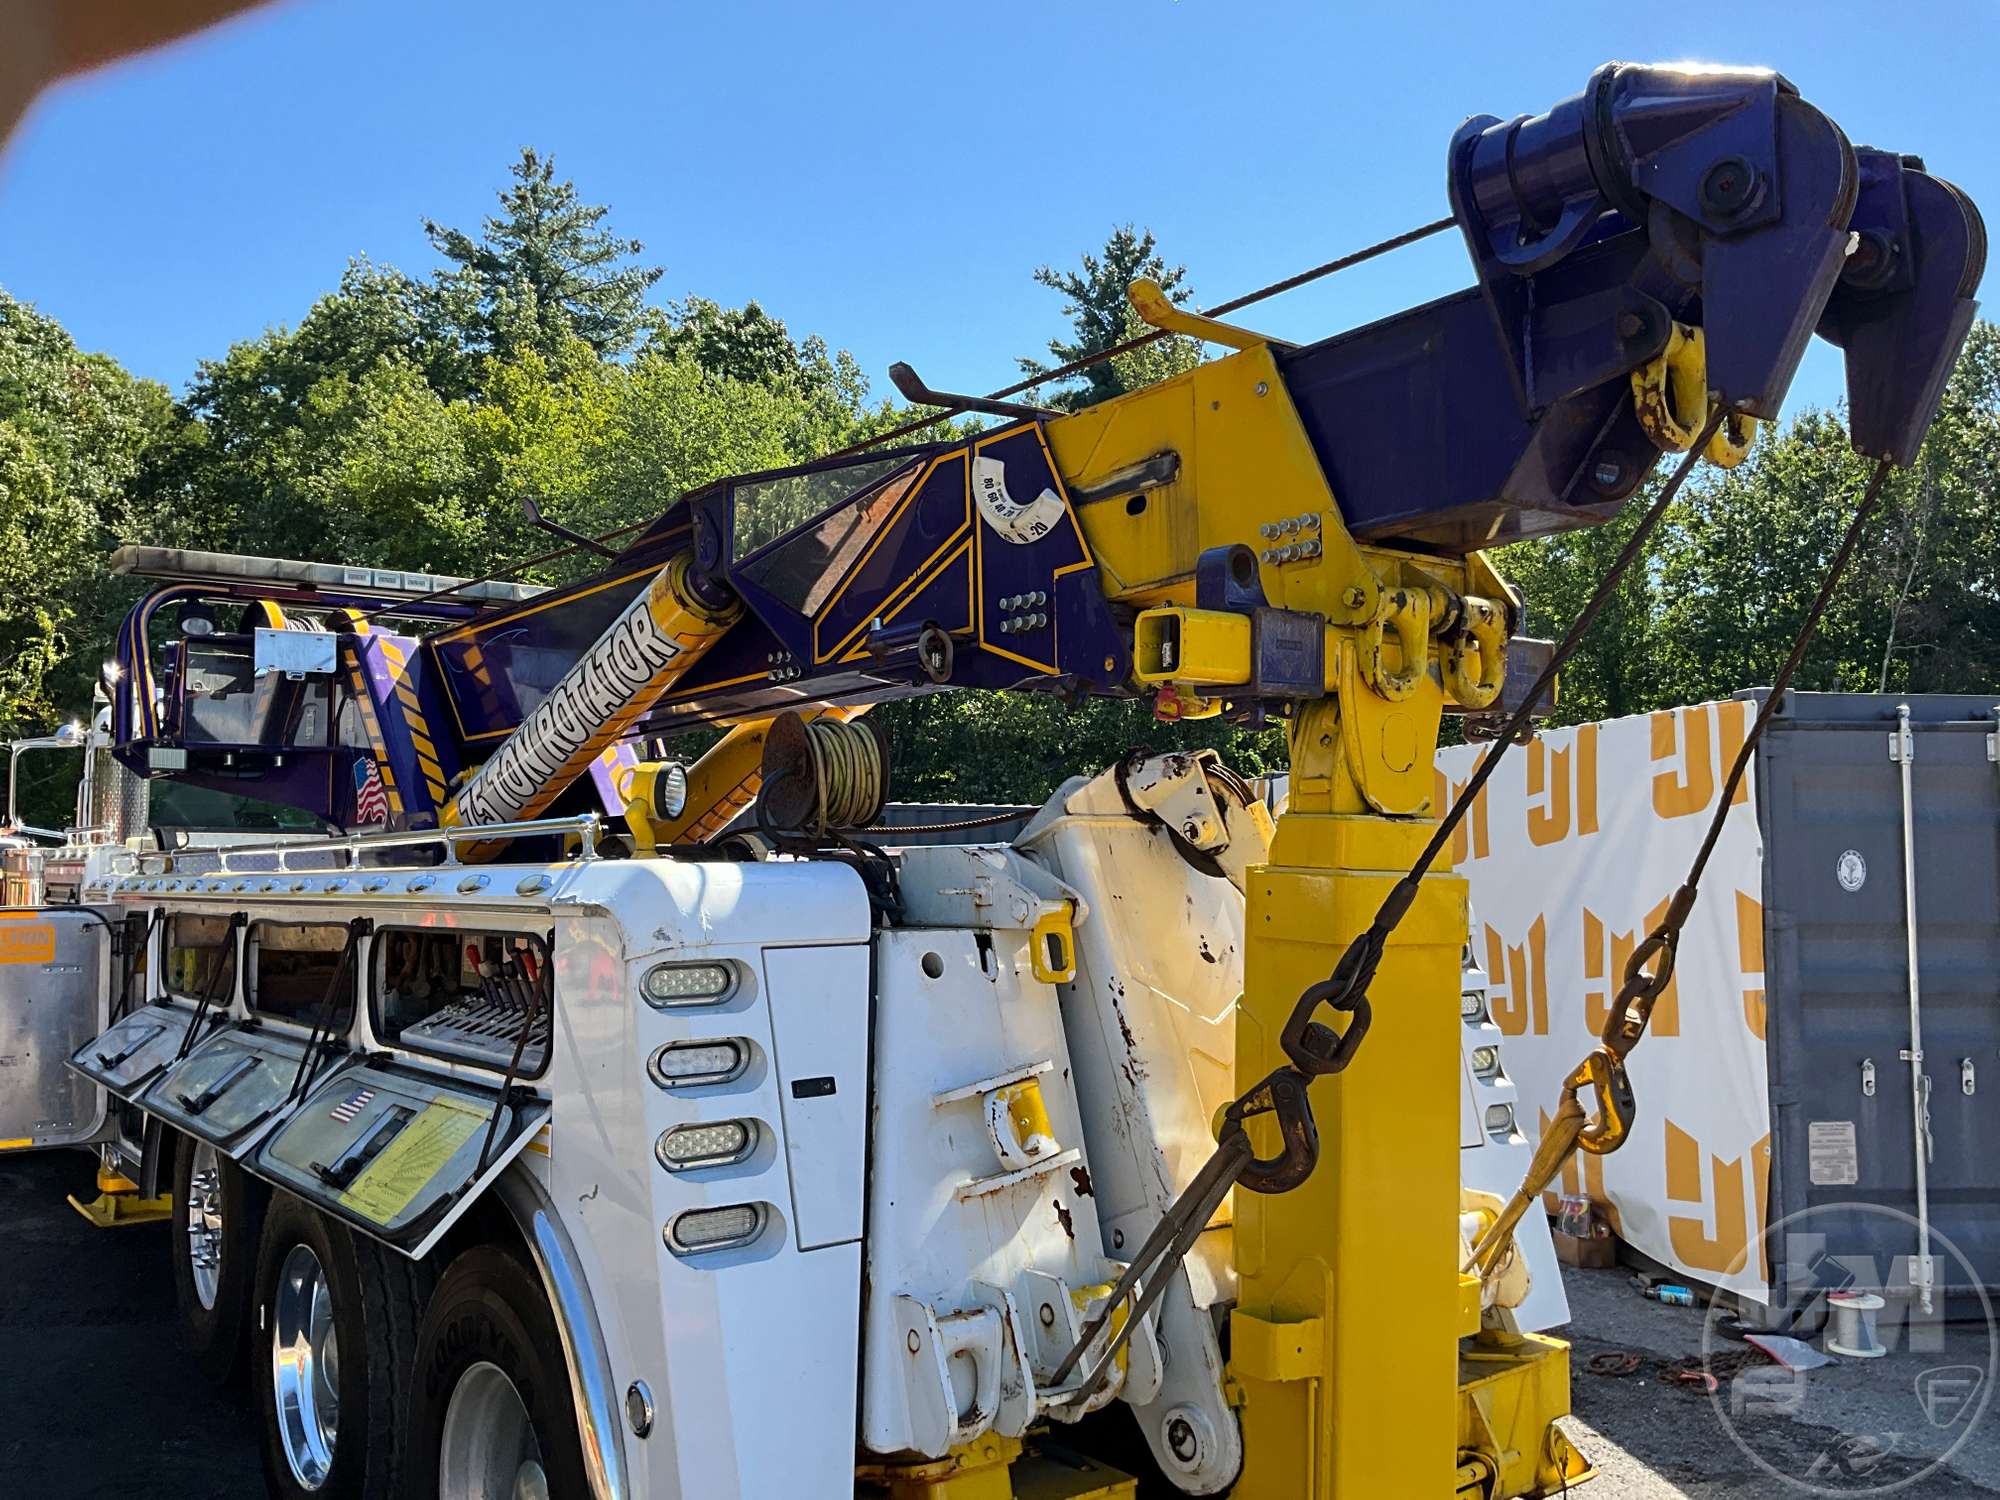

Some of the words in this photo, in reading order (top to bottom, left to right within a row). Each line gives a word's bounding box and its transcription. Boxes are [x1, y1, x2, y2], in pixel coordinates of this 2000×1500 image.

[983, 477, 995, 489] 80
[987, 492, 999, 503] 60
[994, 503, 1006, 513] 40
[1030, 521, 1048, 536] -20
[459, 777, 506, 826] 75
[486, 722, 556, 810] TON
[535, 602, 680, 762] ROTATOR
